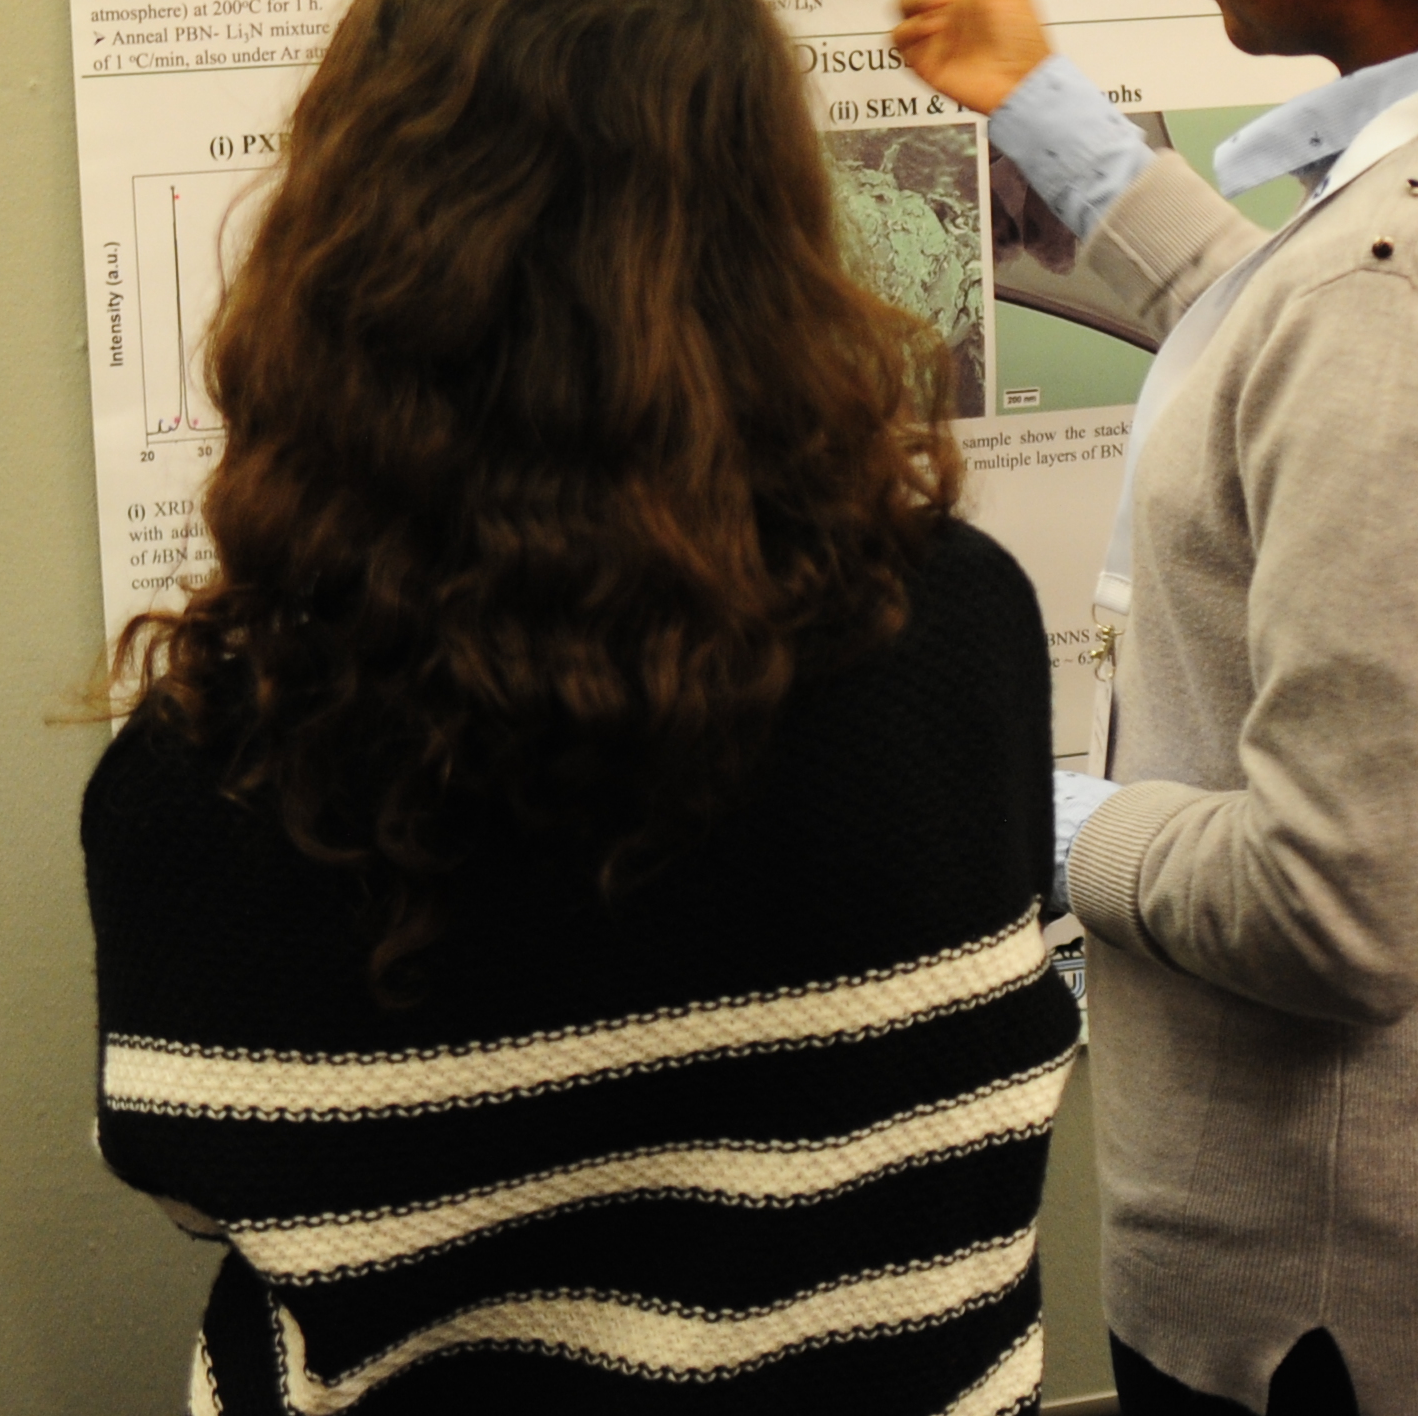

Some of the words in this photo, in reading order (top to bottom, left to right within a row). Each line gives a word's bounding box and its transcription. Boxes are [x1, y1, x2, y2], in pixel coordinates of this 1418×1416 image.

[91, 3, 188, 23] atmosphere)
[194, 4, 208, 17] at
[94, 54, 112, 72] of
[195, 49, 227, 65] also
[232, 47, 276, 63] under
[282, 46, 300, 61] Ar
[829, 100, 859, 124] (ii)
[866, 97, 918, 119] SEM
[107, 291, 124, 368] Intensity
[962, 432, 1012, 450] sample
[1020, 430, 1056, 444] show
[1065, 426, 1086, 440] the
[140, 451, 155, 462] 20
[197, 446, 212, 457] 30
[975, 453, 1031, 470] multiple
[1037, 450, 1077, 467] layers
[1082, 445, 1099, 460] of
[1101, 443, 1125, 459] BN
[127, 503, 146, 522] (i)
[154, 500, 194, 517] XRD
